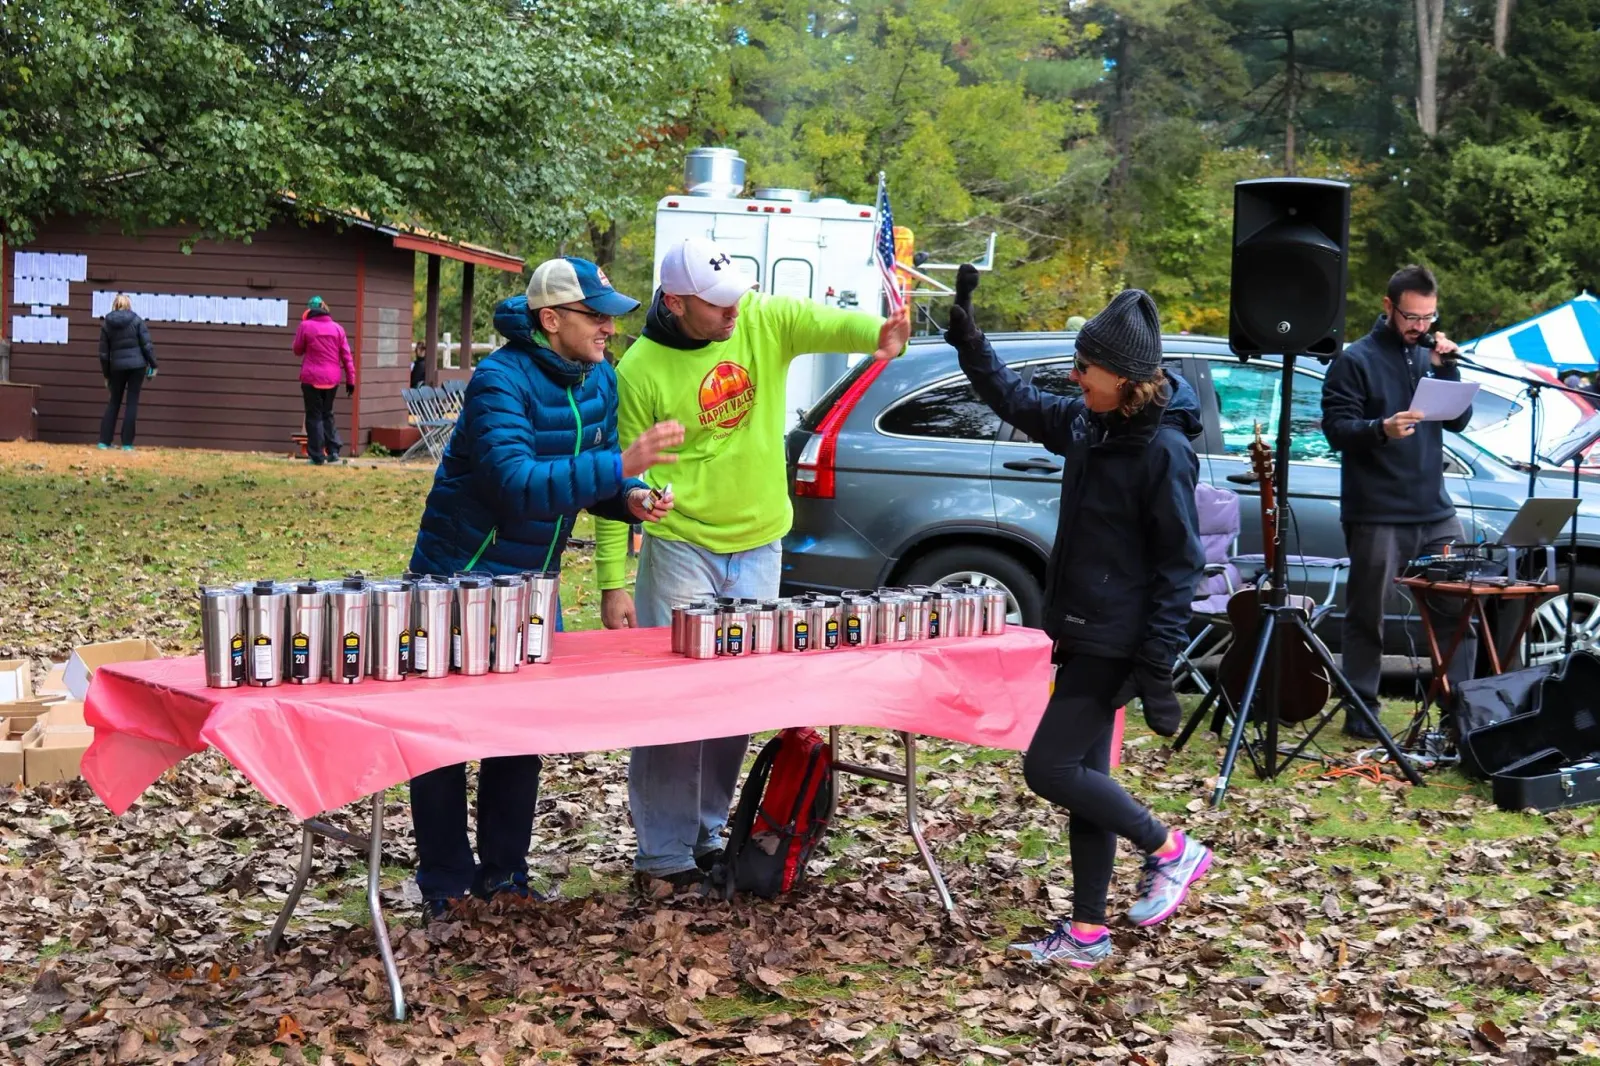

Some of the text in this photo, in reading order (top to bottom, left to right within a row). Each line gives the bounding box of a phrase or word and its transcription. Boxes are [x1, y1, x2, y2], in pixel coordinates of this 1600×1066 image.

[699, 403, 729, 425] HAPPY
[829, 635, 836, 643] 10
[850, 632, 857, 641] 10
[731, 641, 739, 650] 10
[798, 637, 806, 646] 10
[295, 654, 306, 664] 20
[346, 654, 357, 664] 20
